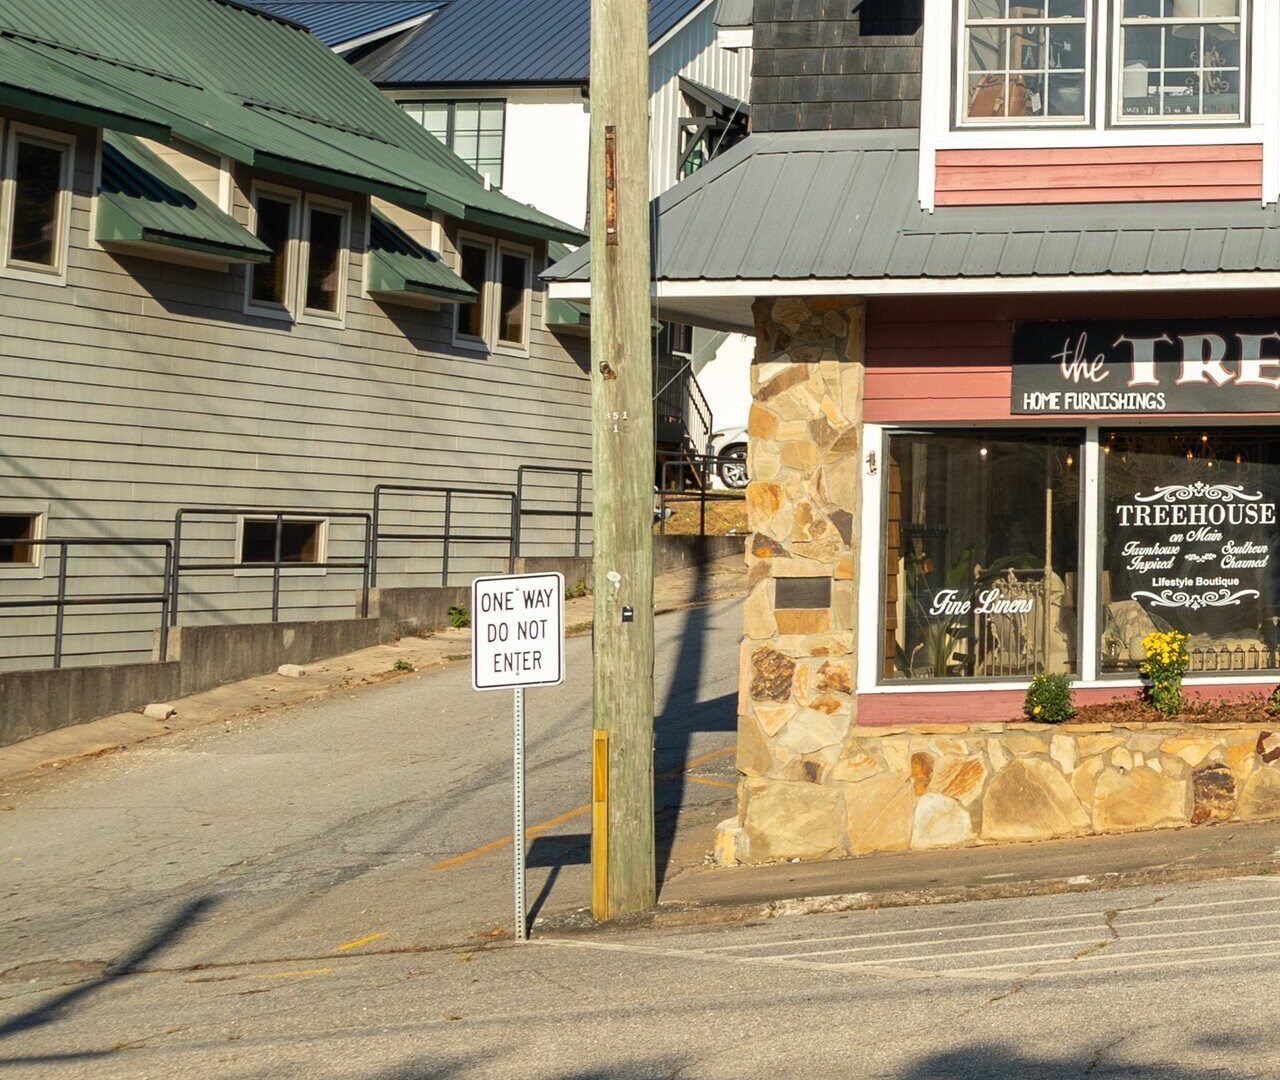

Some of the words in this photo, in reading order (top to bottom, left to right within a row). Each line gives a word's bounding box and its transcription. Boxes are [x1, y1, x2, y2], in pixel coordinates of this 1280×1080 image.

[1051, 331, 1109, 383] the
[1024, 392, 1060, 411] HOME
[1064, 392, 1166, 411] FURNISHINGS
[1116, 503, 1276, 527] TREEHOUSE
[1169, 532, 1184, 543] on
[1186, 527, 1223, 542] Main
[1122, 541, 1180, 557] Farmhouse
[1221, 540, 1268, 555] Southern
[1127, 556, 1176, 573] Inspired
[1220, 555, 1268, 569] Charmed
[1152, 576, 1193, 589] Lifestyle
[1195, 576, 1239, 588] Boutique
[481, 591, 514, 612] ONE
[523, 588, 553, 609] WAY
[929, 589, 971, 616] Fine
[974, 587, 1034, 615] Linens
[488, 622, 508, 643] DO
[517, 619, 548, 640] NOT
[494, 650, 542, 673] ENTER
